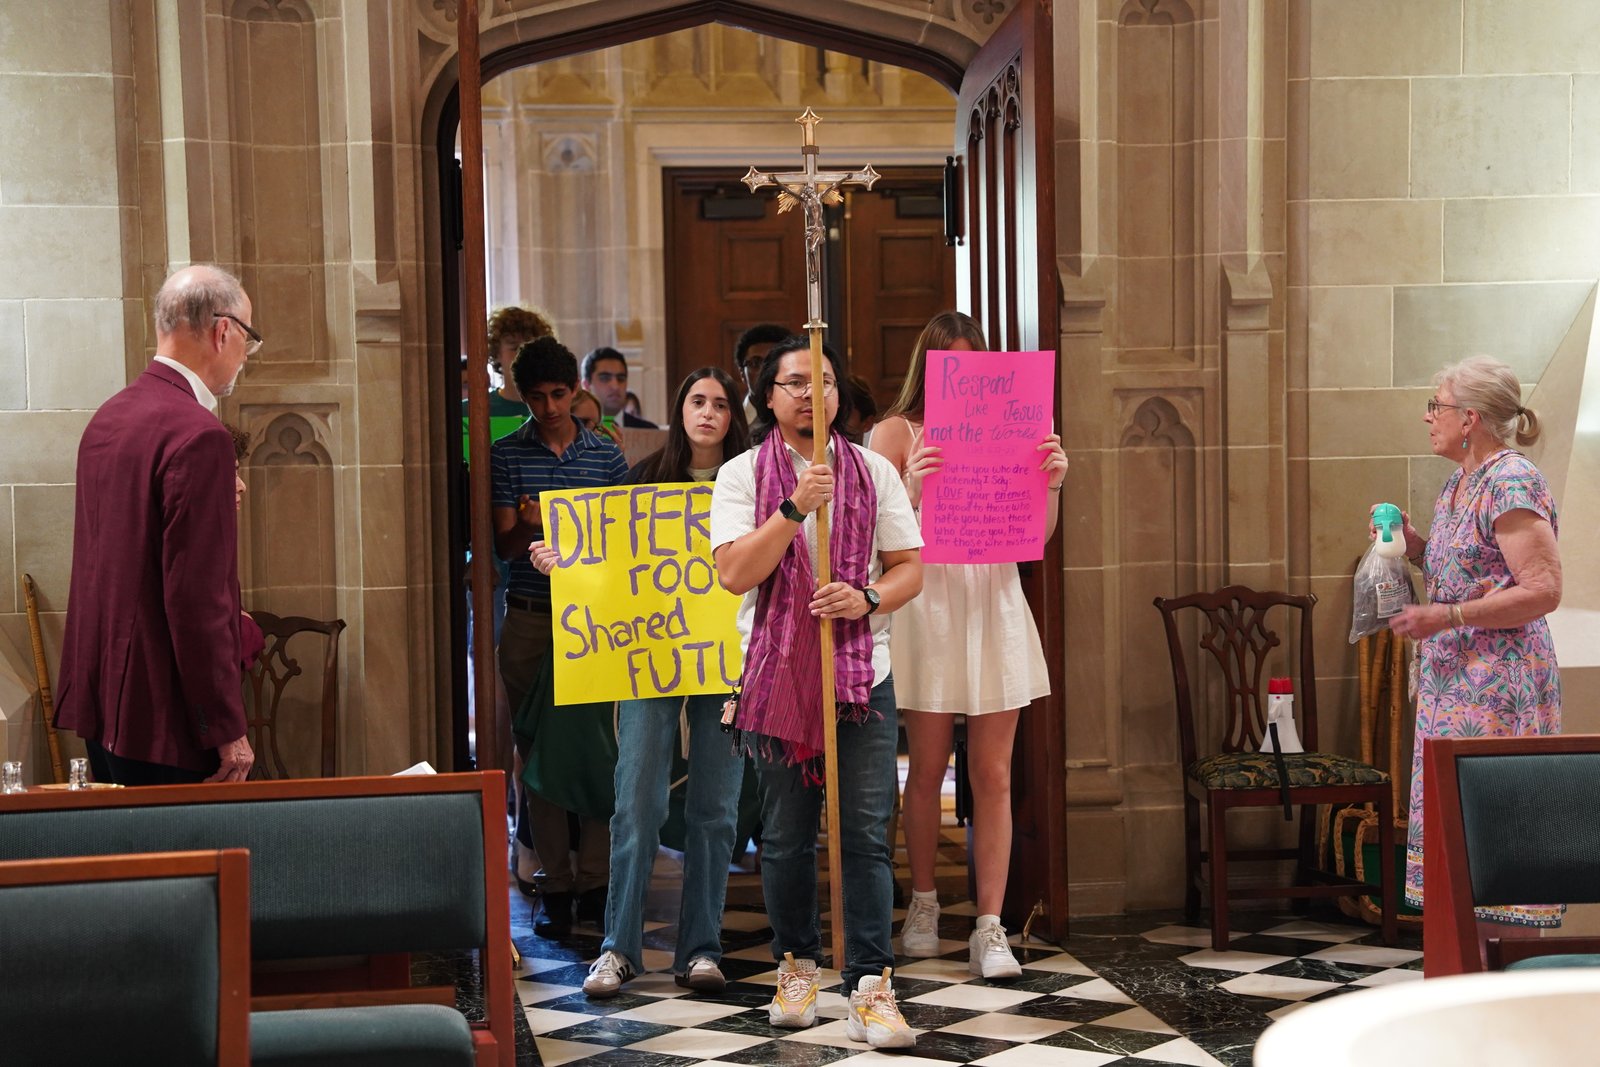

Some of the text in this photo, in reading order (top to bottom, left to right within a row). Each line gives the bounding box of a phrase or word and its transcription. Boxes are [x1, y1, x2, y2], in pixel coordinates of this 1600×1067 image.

[942, 356, 1015, 400] Respond
[1003, 399, 1043, 421] Jesus
[930, 425, 953, 441] not
[958, 422, 984, 443] the
[961, 464, 970, 473] to
[973, 466, 989, 478] you
[992, 465, 1011, 473] who
[1012, 464, 1029, 475] are
[984, 475, 989, 484] I
[936, 485, 963, 499] LOVE
[967, 491, 991, 503] your
[935, 501, 1031, 515] do good to those who
[549, 485, 712, 568] DIFFER
[934, 513, 959, 524] hate
[983, 514, 1005, 524] bless
[1008, 514, 1033, 522] those
[934, 526, 955, 536] who
[953, 536, 982, 547] those
[985, 538, 1003, 547] who
[629, 556, 727, 596] roo
[560, 597, 691, 660] Shared
[627, 641, 741, 698] FUTU
